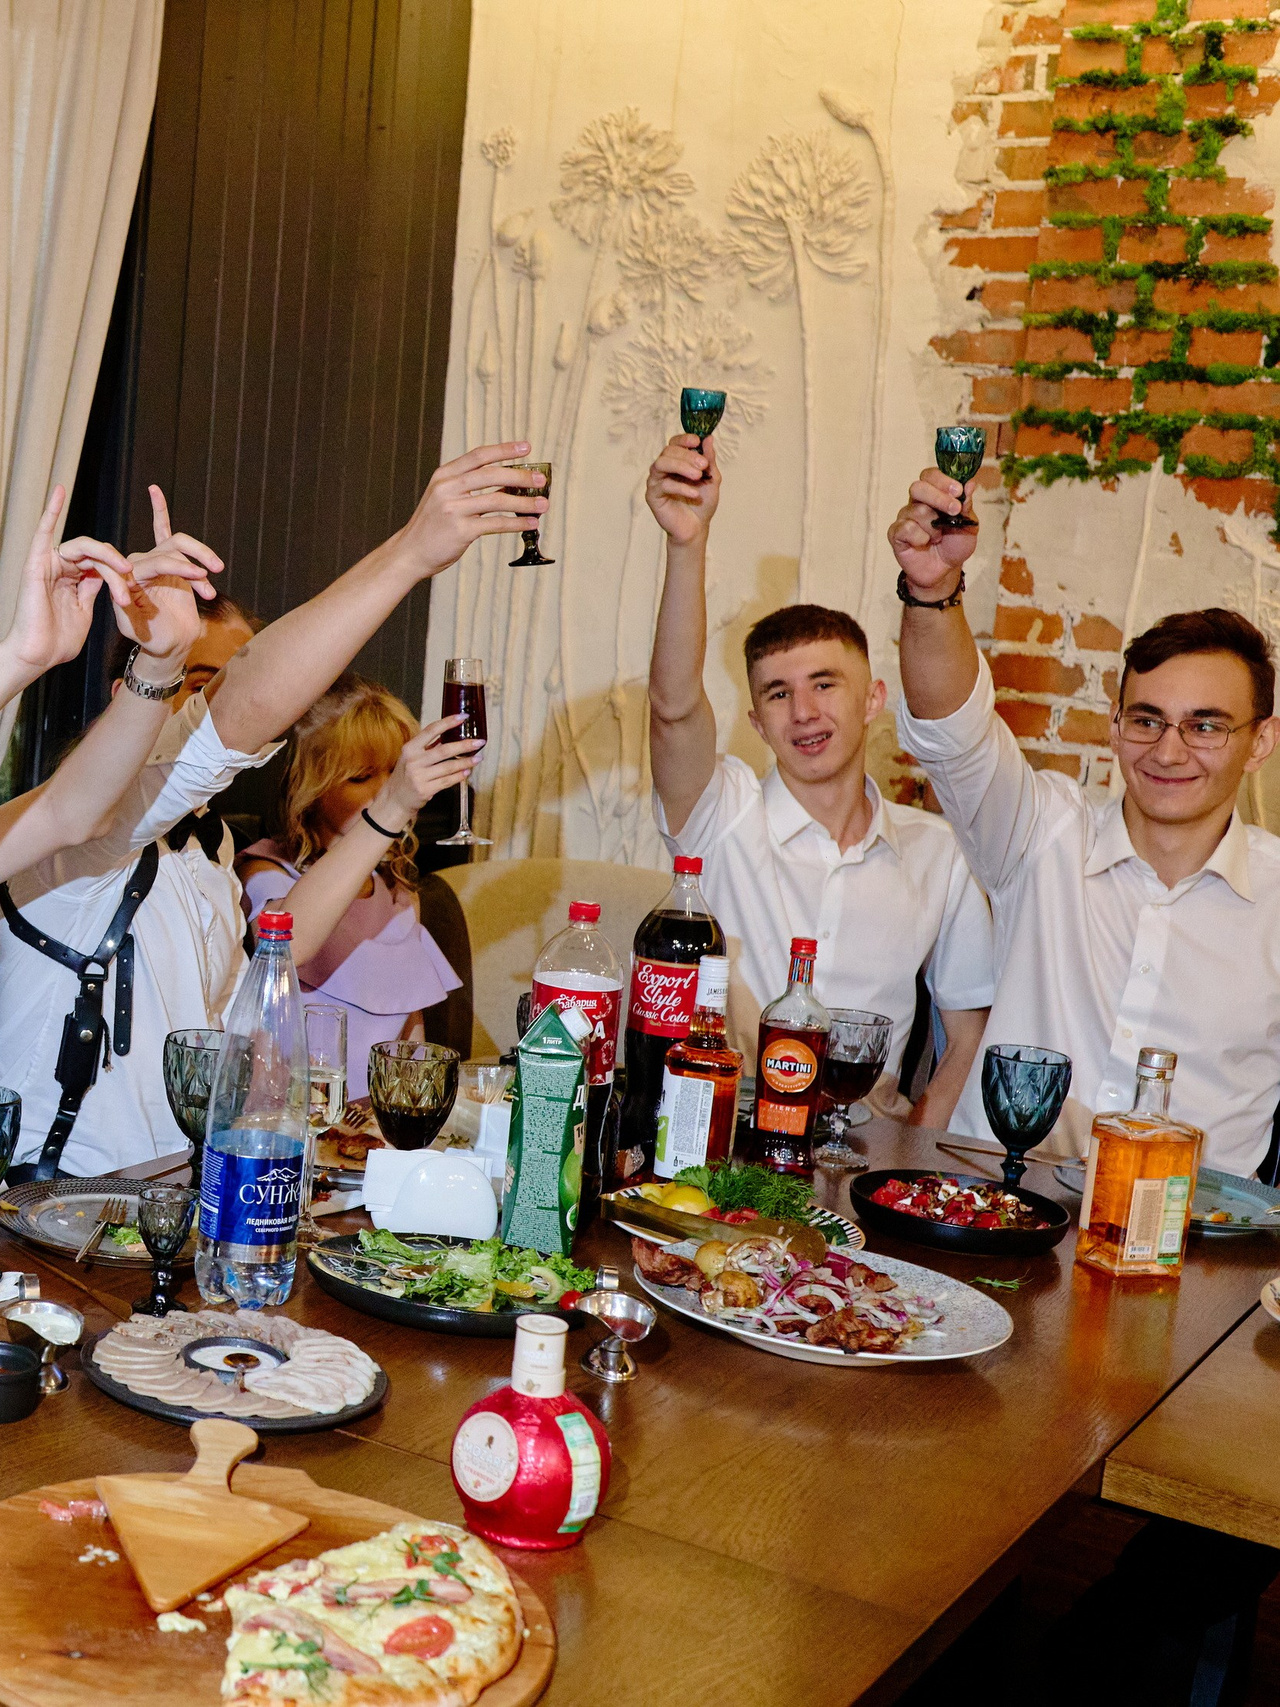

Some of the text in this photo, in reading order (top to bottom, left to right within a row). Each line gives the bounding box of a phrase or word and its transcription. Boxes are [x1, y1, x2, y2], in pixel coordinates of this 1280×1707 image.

[638, 964, 696, 994] Export
[556, 994, 597, 1009] Бавария
[641, 985, 682, 1010] Style
[632, 1002, 690, 1023] Classic Cola
[766, 1058, 812, 1073] MARTINI
[769, 1103, 797, 1113] FIERO
[246, 1218, 288, 1226] ЛЕДНИКОВАЯ
[464, 1441, 507, 1467] MOZART
